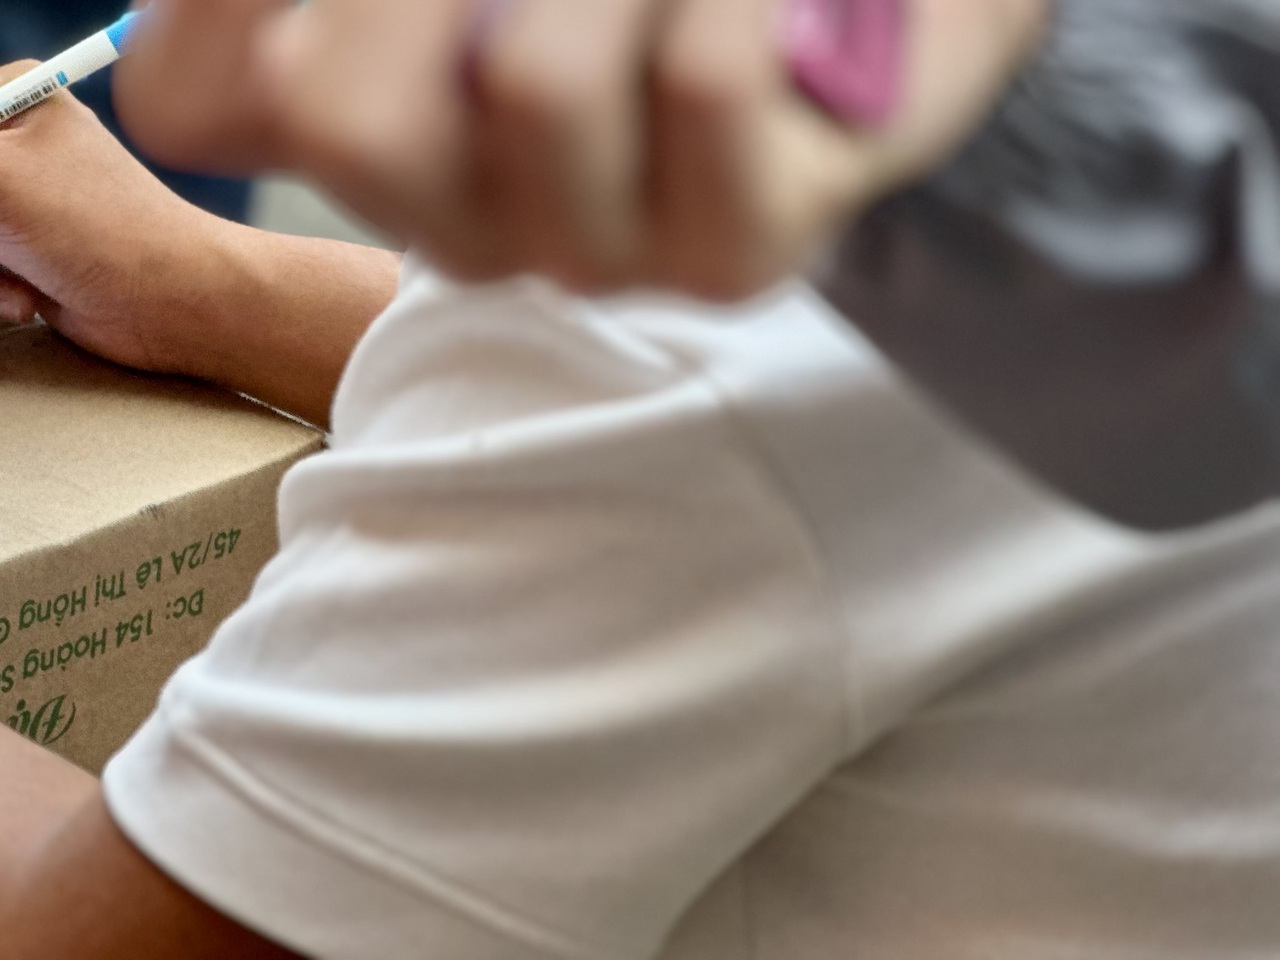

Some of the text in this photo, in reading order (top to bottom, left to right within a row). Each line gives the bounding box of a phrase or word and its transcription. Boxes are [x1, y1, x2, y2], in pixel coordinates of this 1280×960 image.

[171, 527, 241, 575] 45/2A
[94, 571, 127, 607] Thị
[135, 556, 162, 590] Lê
[19, 586, 87, 630] Hồng
[116, 609, 153, 648] 154
[22, 627, 107, 680] Hoàng
